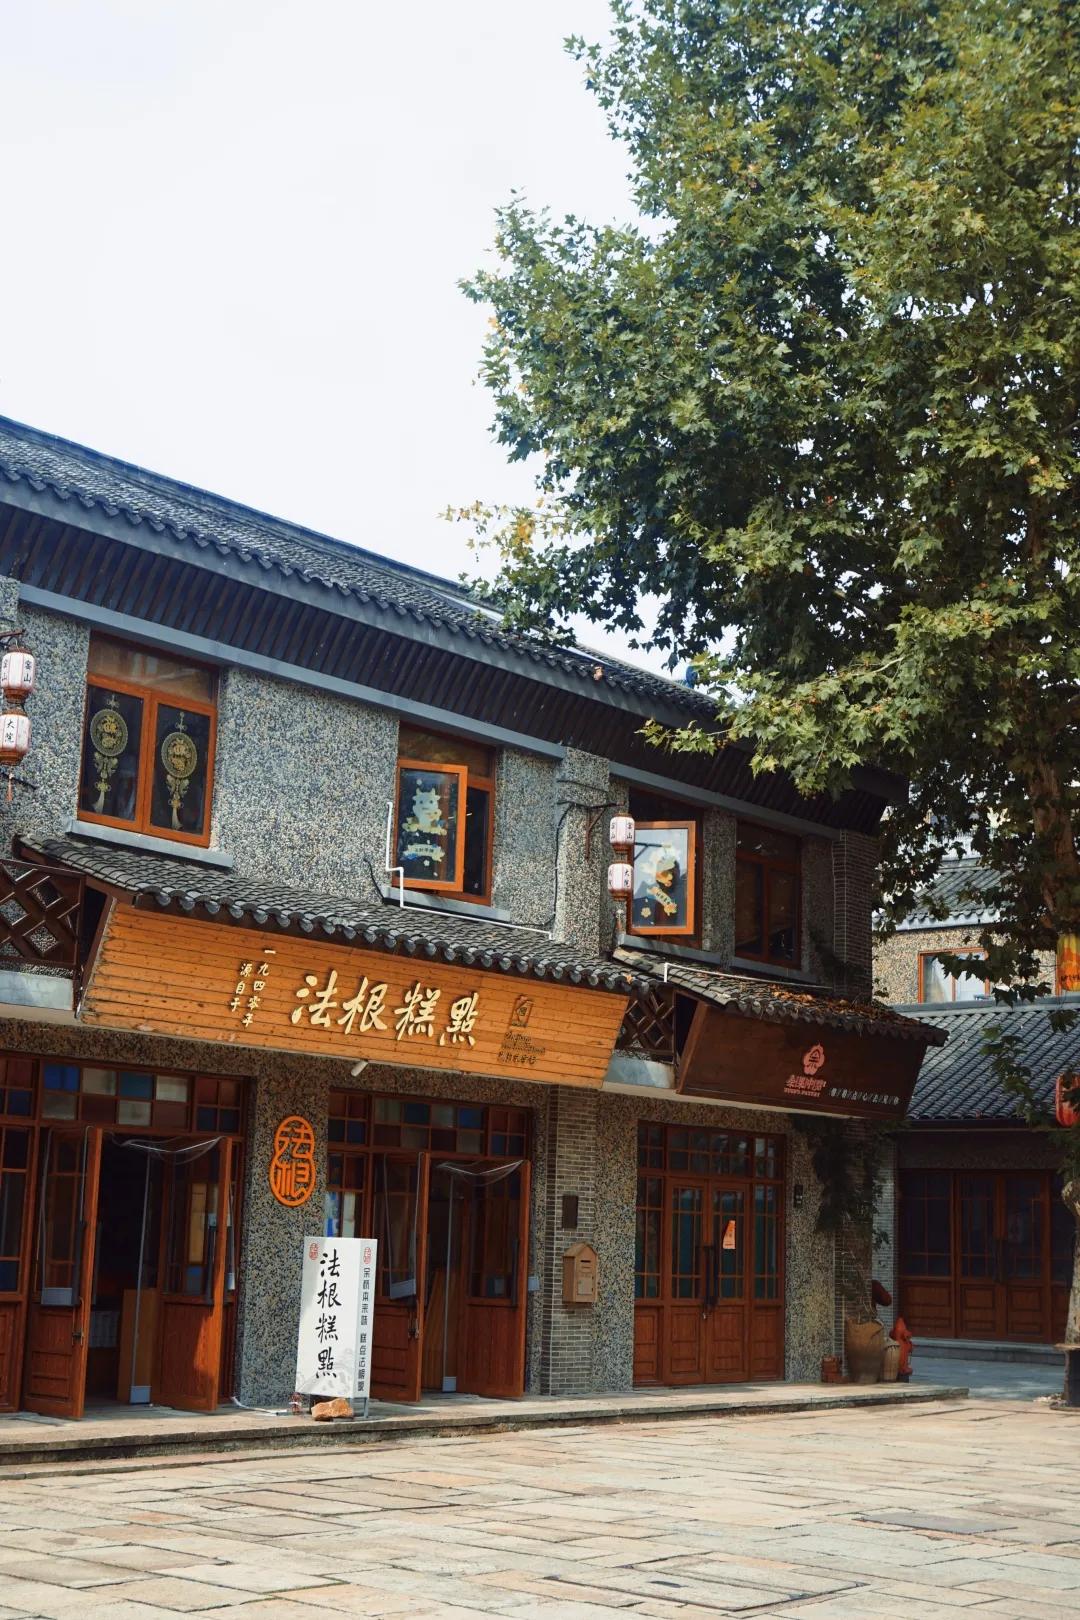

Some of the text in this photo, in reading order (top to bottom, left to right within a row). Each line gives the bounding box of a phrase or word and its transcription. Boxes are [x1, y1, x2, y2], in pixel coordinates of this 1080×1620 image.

[230, 963, 253, 1012] 源自于
[291, 969, 480, 1047] 法根糕點
[315, 1248, 342, 1379] 法根糕點
